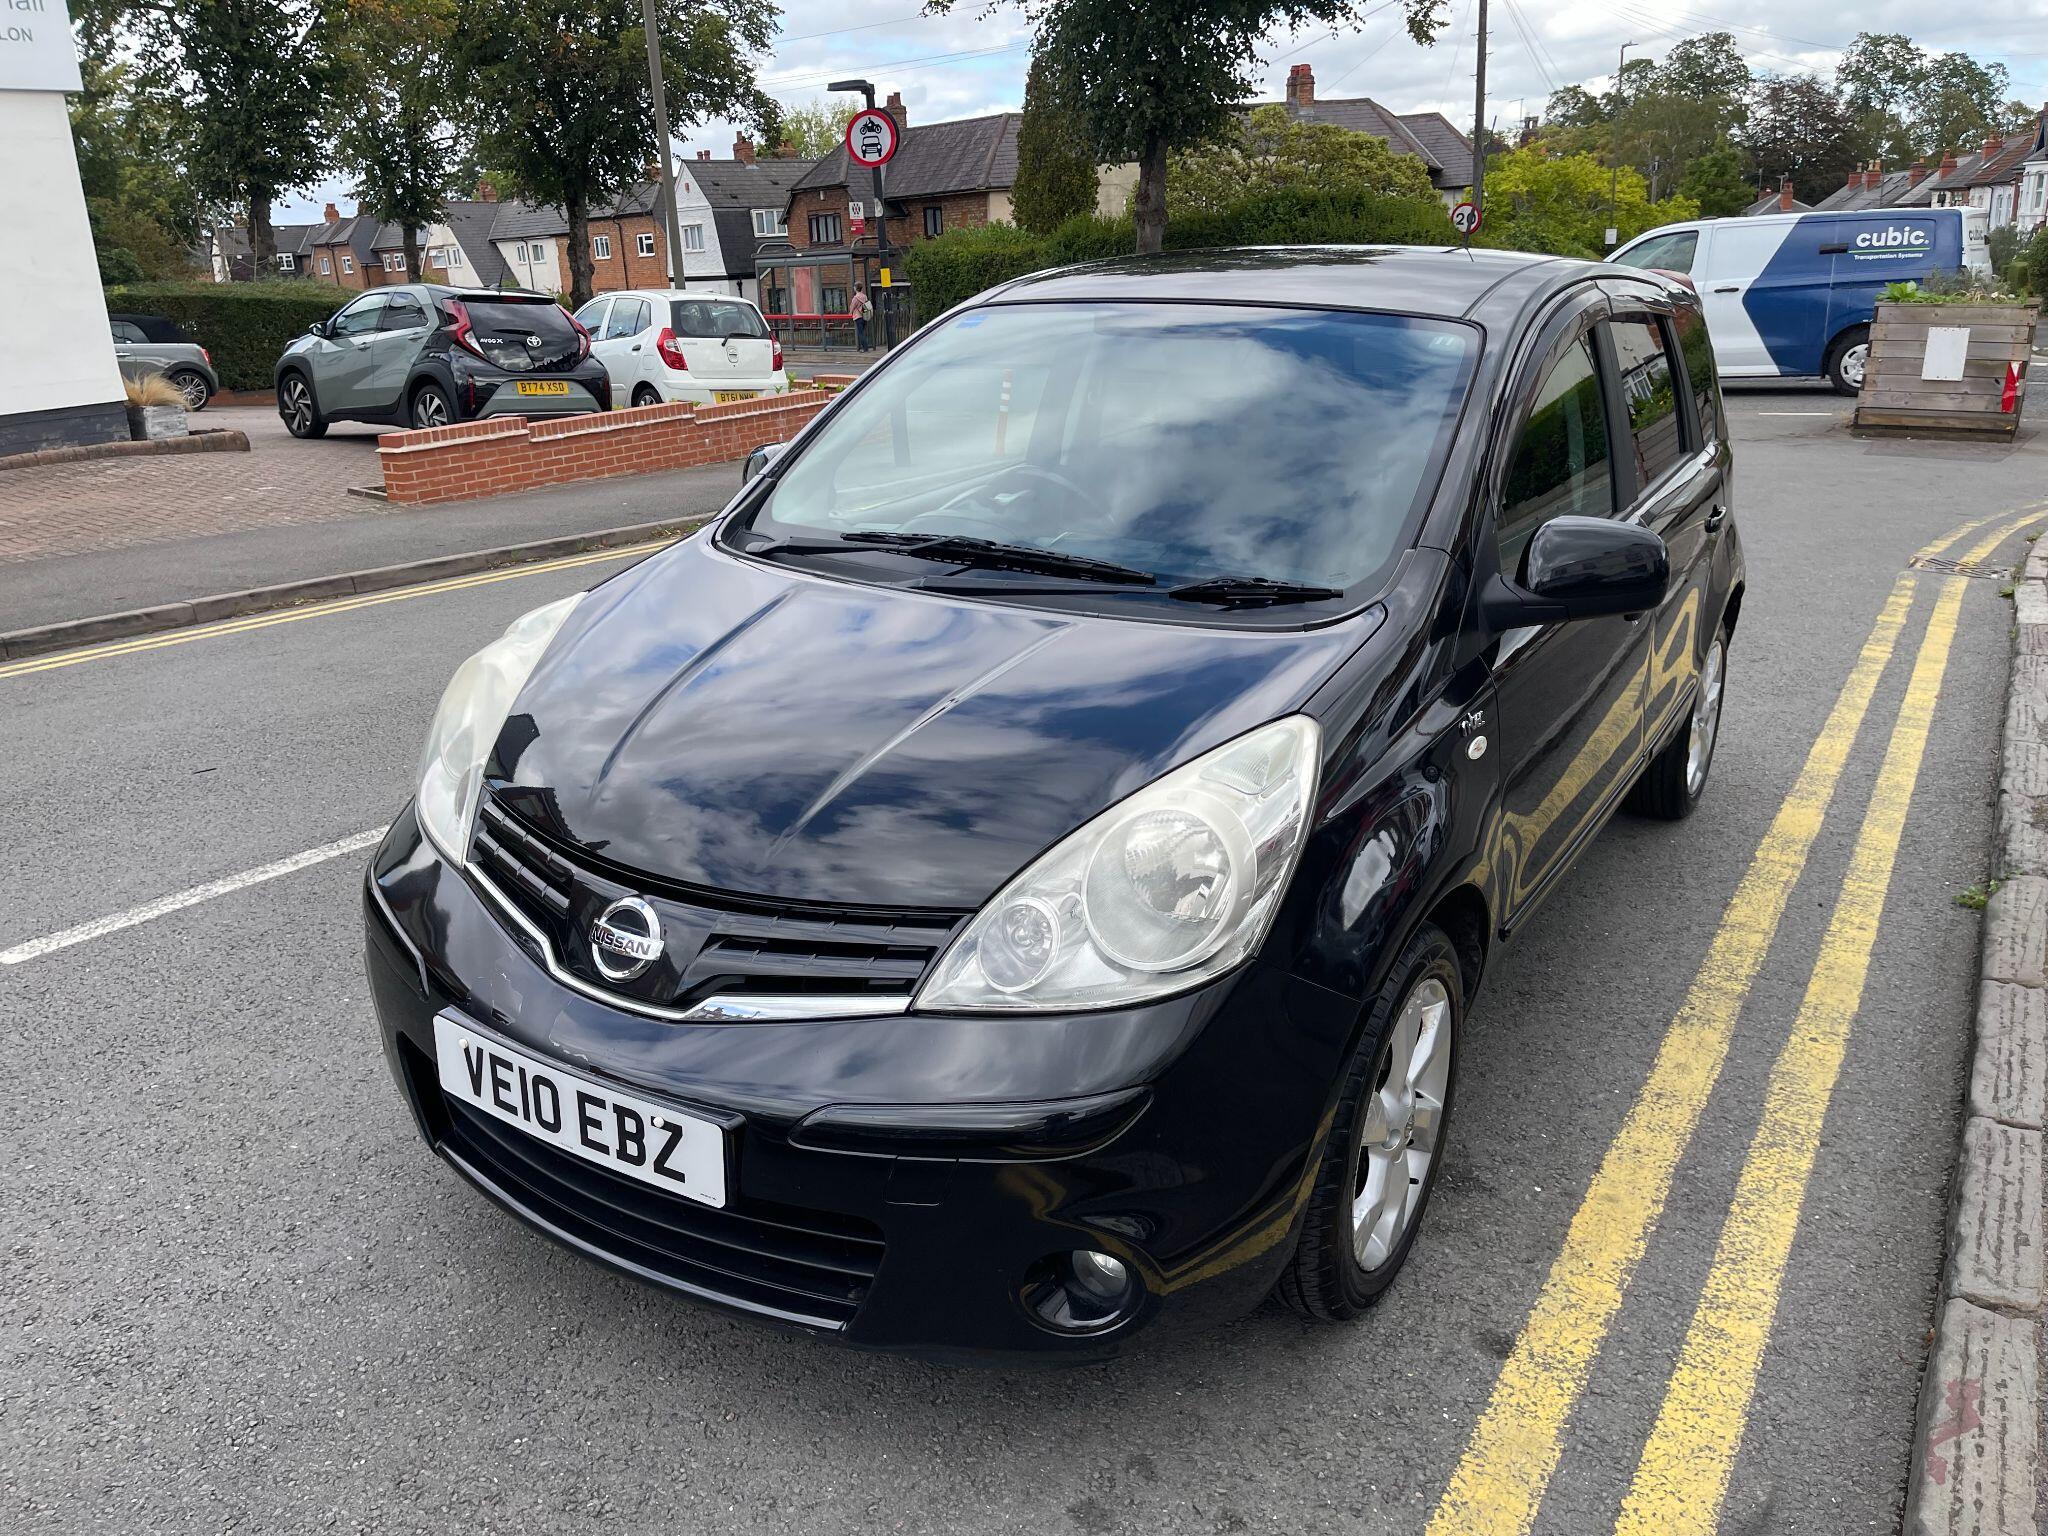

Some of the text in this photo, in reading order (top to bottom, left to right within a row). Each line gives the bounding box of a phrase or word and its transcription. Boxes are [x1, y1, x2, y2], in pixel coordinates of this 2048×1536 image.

[1456, 212, 1477, 226] 20
[1854, 252, 1924, 261] Transportation Systems
[521, 382, 565, 393] BT74 XSD
[591, 922, 651, 956] NISSAN
[462, 1045, 686, 1184] VE10 EBZ
